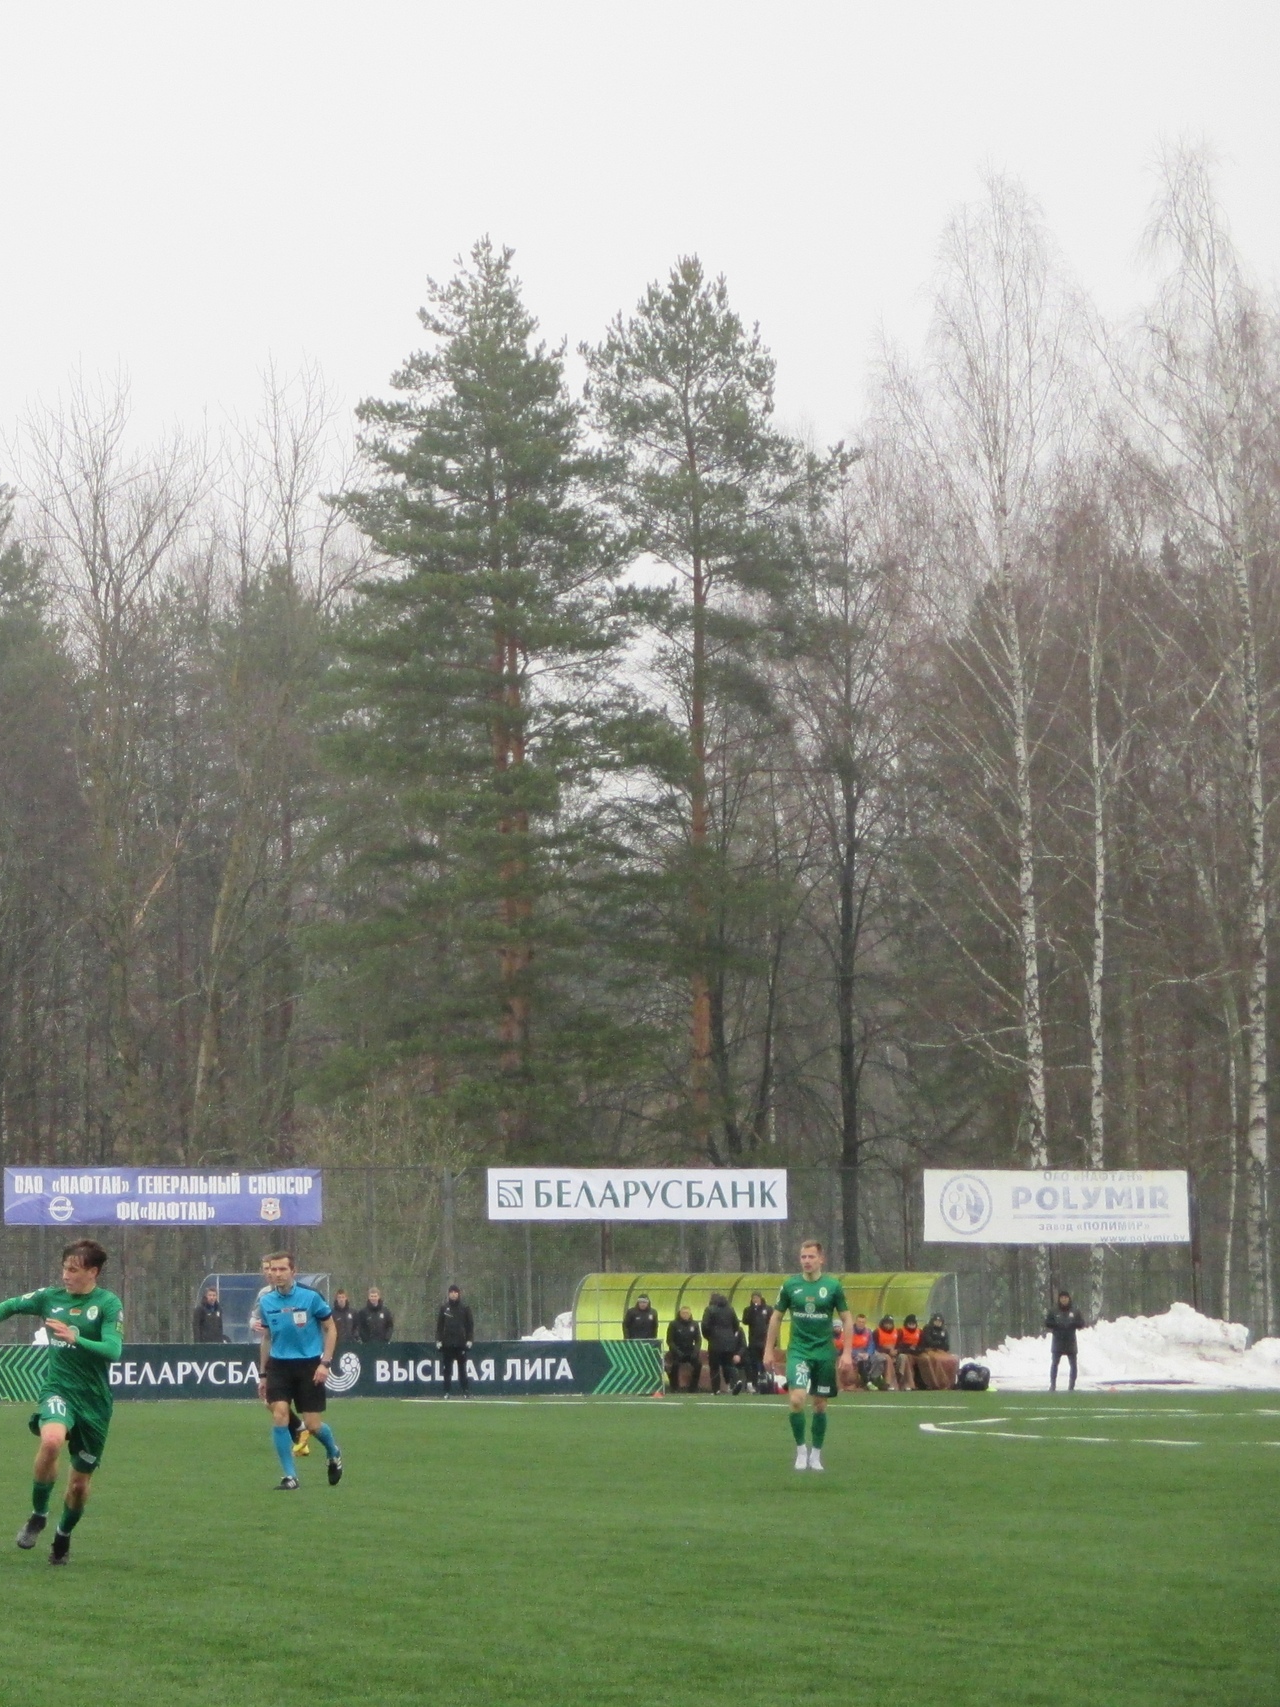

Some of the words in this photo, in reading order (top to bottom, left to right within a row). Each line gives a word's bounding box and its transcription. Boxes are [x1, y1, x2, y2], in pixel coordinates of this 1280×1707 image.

[14, 1175, 44, 1194] ОАО
[51, 1175, 130, 1194] «НАФТАН»
[137, 1172, 241, 1194] ГЕНЕРАЛЬНЫЙ
[248, 1175, 313, 1195] СПОНСОР
[534, 1179, 779, 1209] БЕЛАРУСБАНК
[1011, 1185, 1170, 1211] POLYMIR
[108, 1361, 262, 1385] БЕЛАРУСБА
[502, 1358, 575, 1381] ЛИГА
